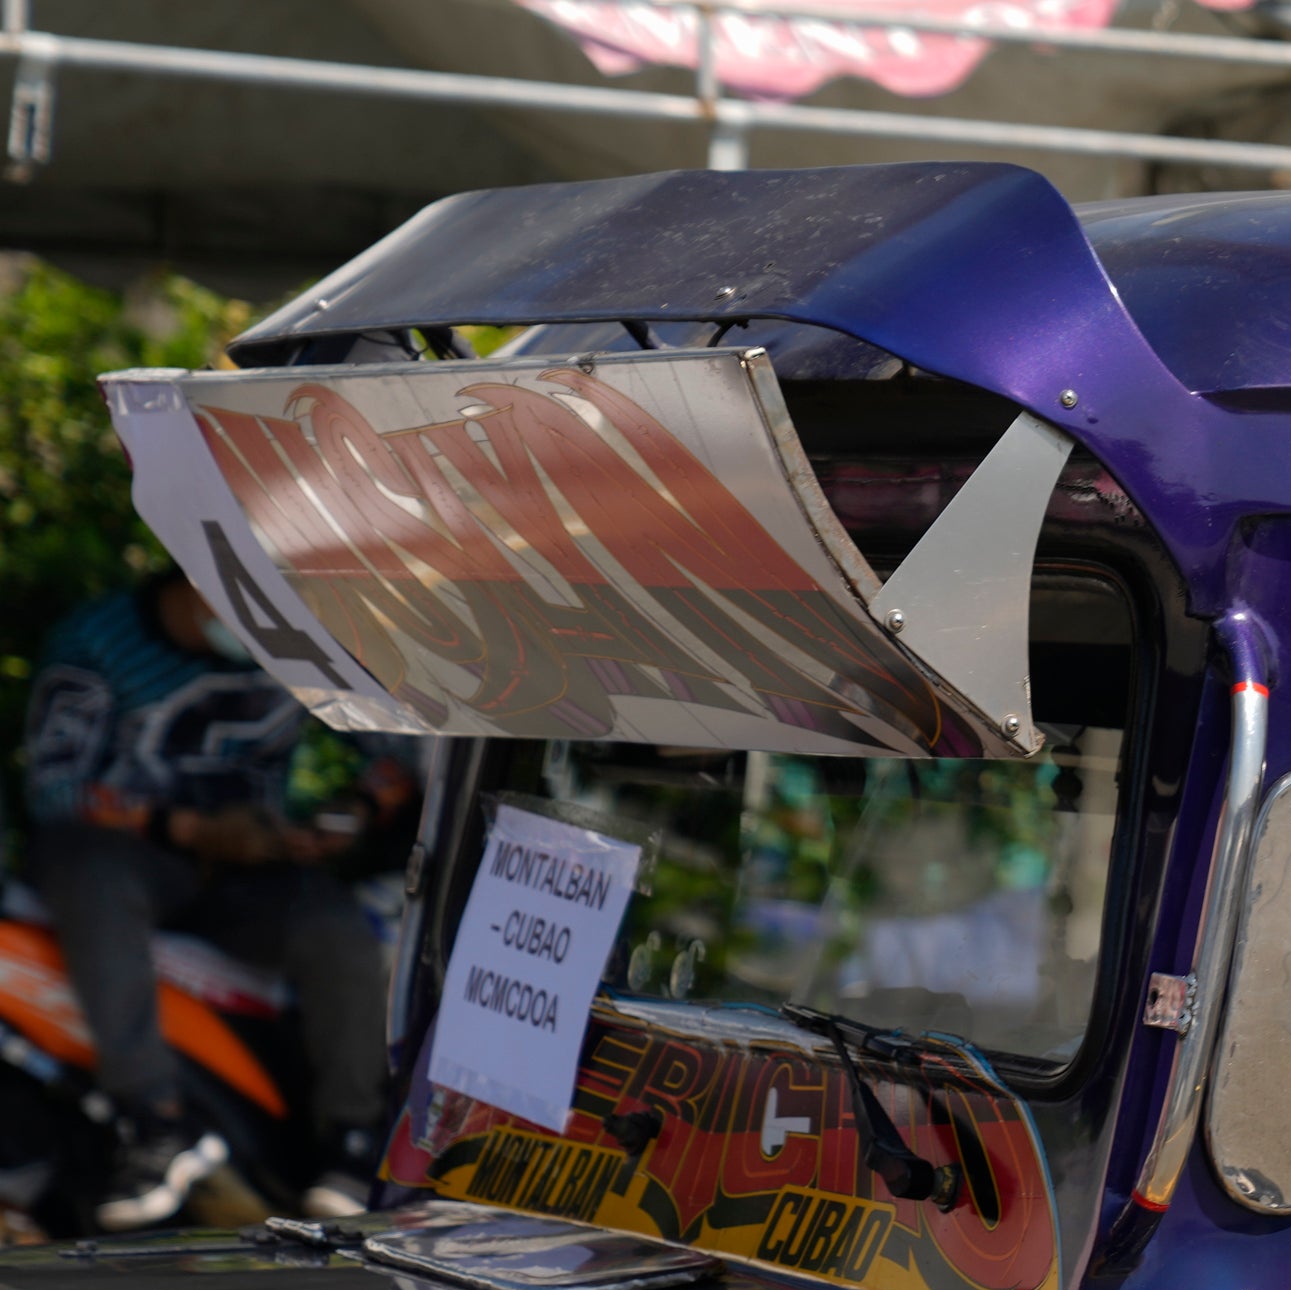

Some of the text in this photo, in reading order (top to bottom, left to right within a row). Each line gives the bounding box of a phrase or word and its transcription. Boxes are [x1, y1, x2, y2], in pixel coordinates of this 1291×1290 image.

[202, 521, 353, 691] 4
[490, 841, 612, 911] MONTALBAN
[464, 965, 559, 1032] MCMCDOA
[466, 1131, 623, 1223] MONTALBAN
[757, 1192, 895, 1283] CUBAO
